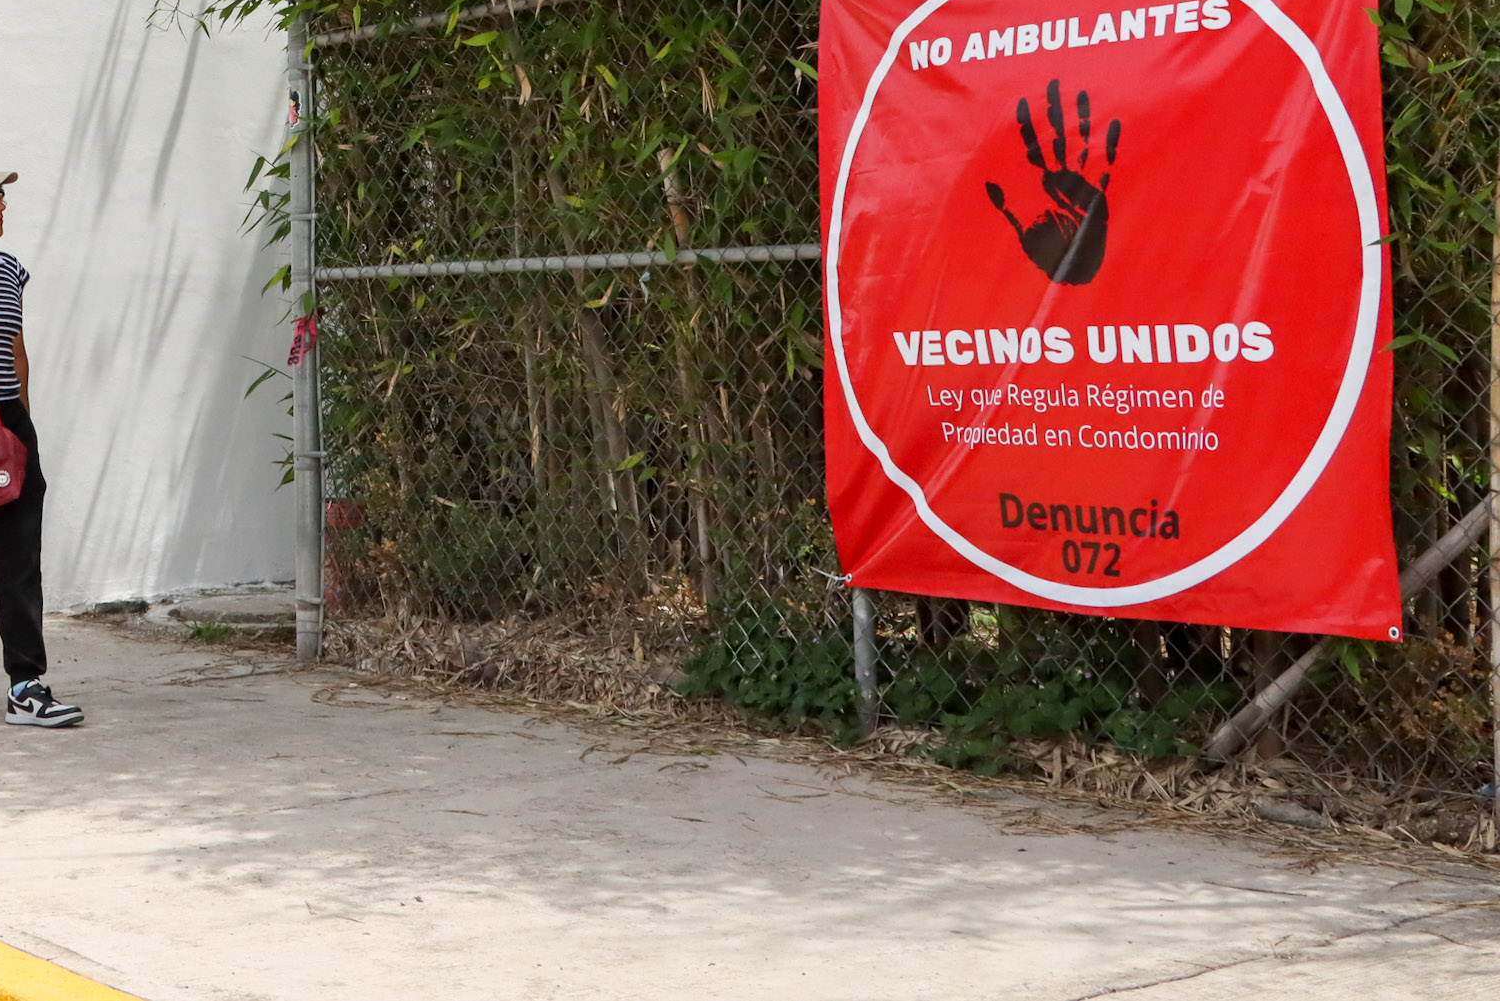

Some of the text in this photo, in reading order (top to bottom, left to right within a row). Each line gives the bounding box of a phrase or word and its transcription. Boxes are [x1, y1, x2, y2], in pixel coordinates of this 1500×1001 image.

[909, 37, 953, 71] NO
[893, 321, 1275, 366] VECINOS UNIDOS
[927, 383, 1225, 415] Ley que Regula Régimen de
[941, 421, 1220, 451] Propiedad en Condominio
[998, 492, 1180, 540] Denuncia
[1062, 539, 1122, 577] 072
